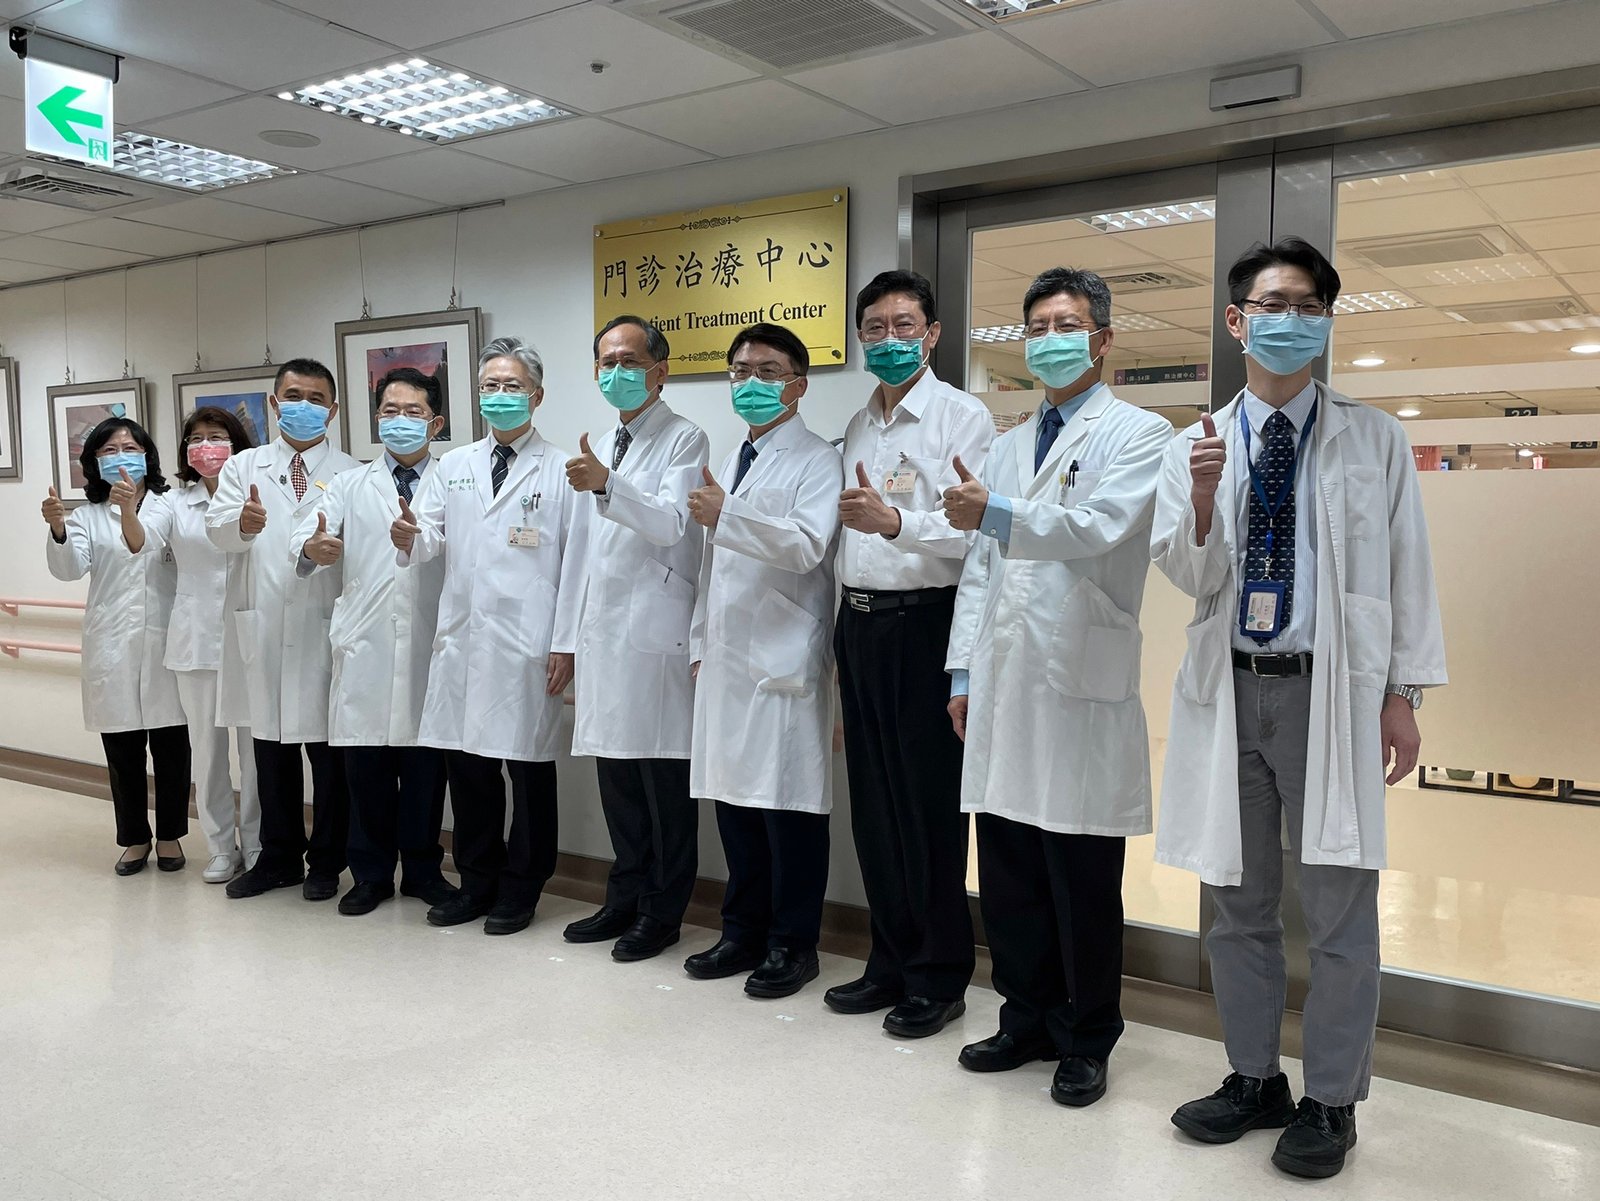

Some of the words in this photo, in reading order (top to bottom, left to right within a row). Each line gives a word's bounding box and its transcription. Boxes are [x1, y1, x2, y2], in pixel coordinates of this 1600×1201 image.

[603, 237, 834, 298] 門診治療中心
[650, 314, 682, 333] tient
[685, 305, 765, 330] Treatment
[769, 302, 827, 322] Center
